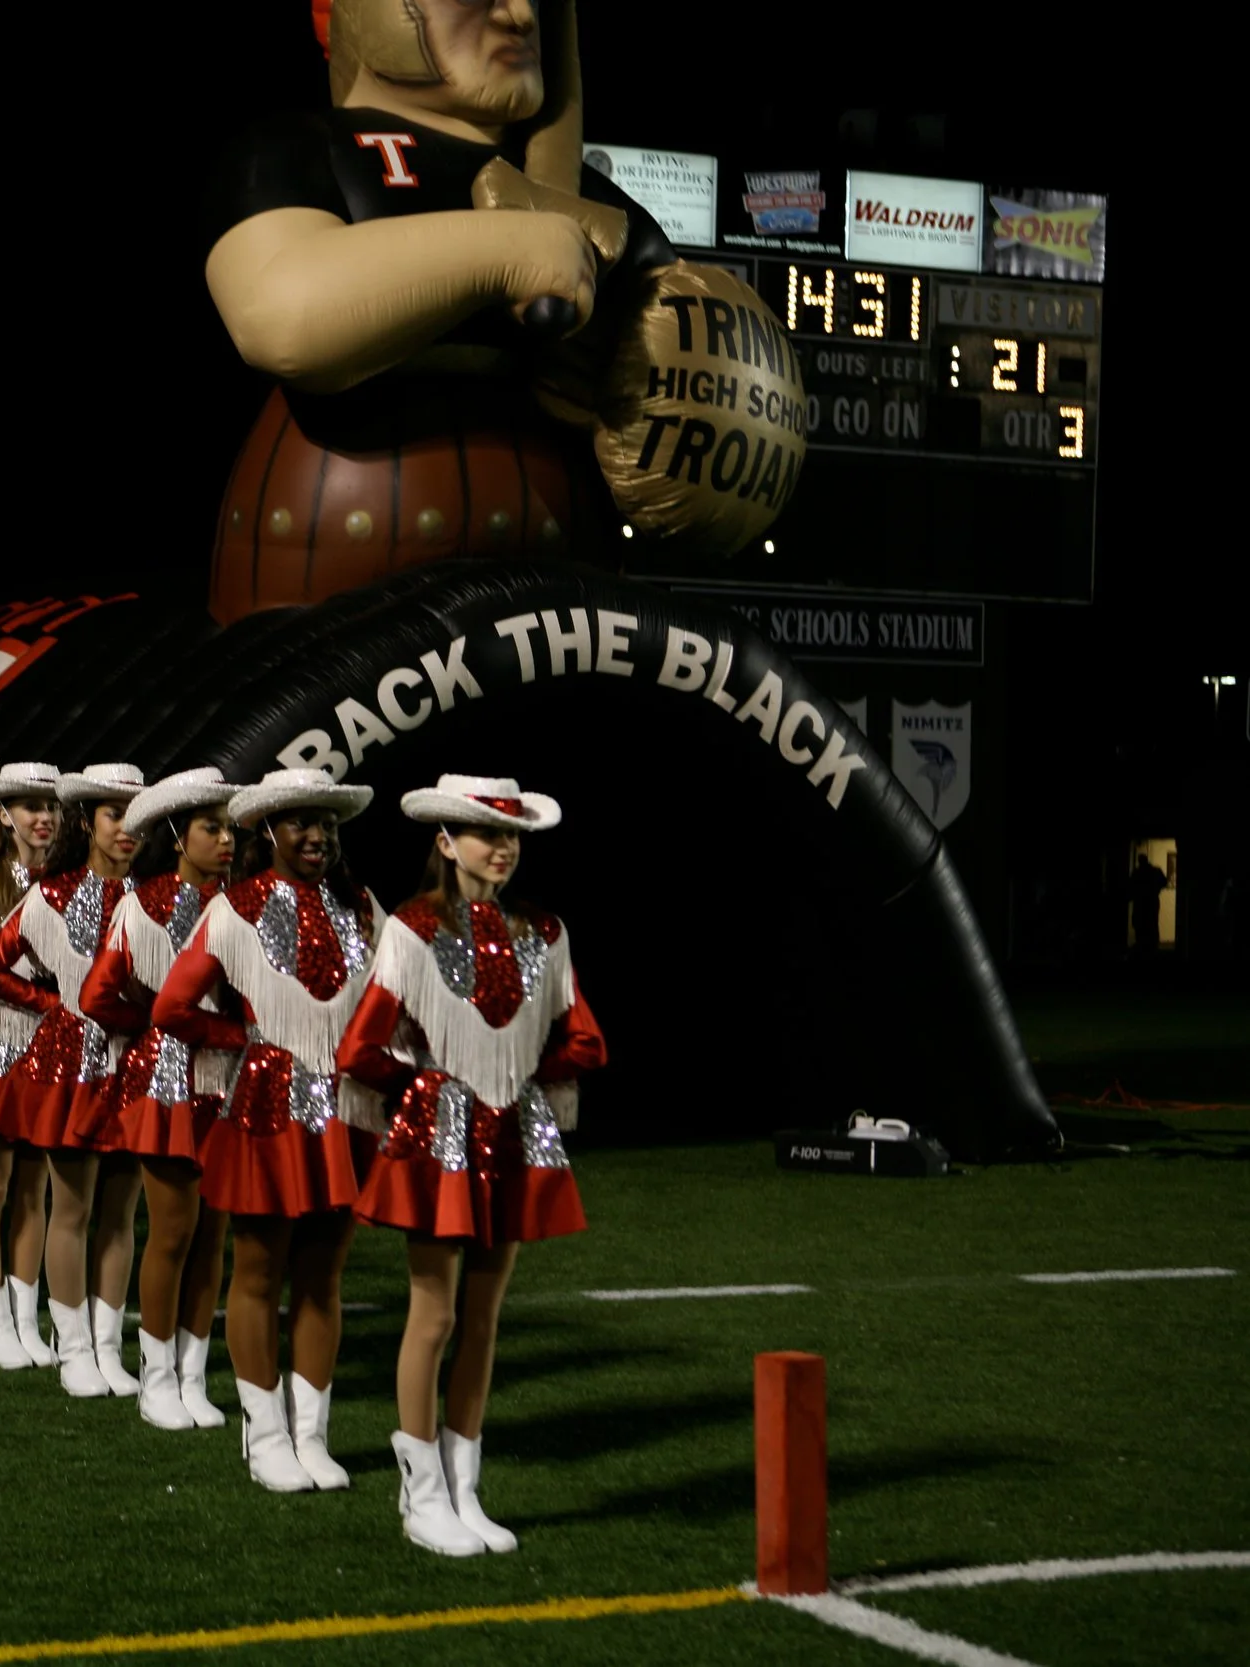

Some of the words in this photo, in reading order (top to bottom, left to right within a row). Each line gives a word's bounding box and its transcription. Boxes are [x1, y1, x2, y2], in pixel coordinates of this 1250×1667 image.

[352, 131, 421, 189] T
[616, 165, 714, 185] ORTHOPEDICS
[640, 152, 690, 168] IRVING
[855, 198, 975, 232] WALDRUM
[871, 227, 916, 241] LIGHTING
[918, 231, 925, 241] &
[927, 233, 958, 245] SIGNS
[994, 215, 1095, 249] SONIC
[950, 289, 1085, 330] VISITOR
[659, 295, 798, 386] TRINIT
[816, 351, 867, 377] OUTS
[881, 356, 927, 383] LEFT
[992, 337, 1047, 394] 21
[648, 366, 738, 412] HIGH
[748, 384, 808, 442] SCHO
[832, 395, 871, 437] GO
[881, 401, 921, 441] ON
[1003, 408, 1052, 450] QTR
[1058, 405, 1085, 459] 3
[769, 606, 871, 648] SCHOOLS
[877, 612, 975, 653] STADIUM
[275, 634, 485, 784] BACK
[494, 607, 638, 683] THE
[656, 625, 867, 811] BLACK
[901, 715, 964, 731] NIMITZ
